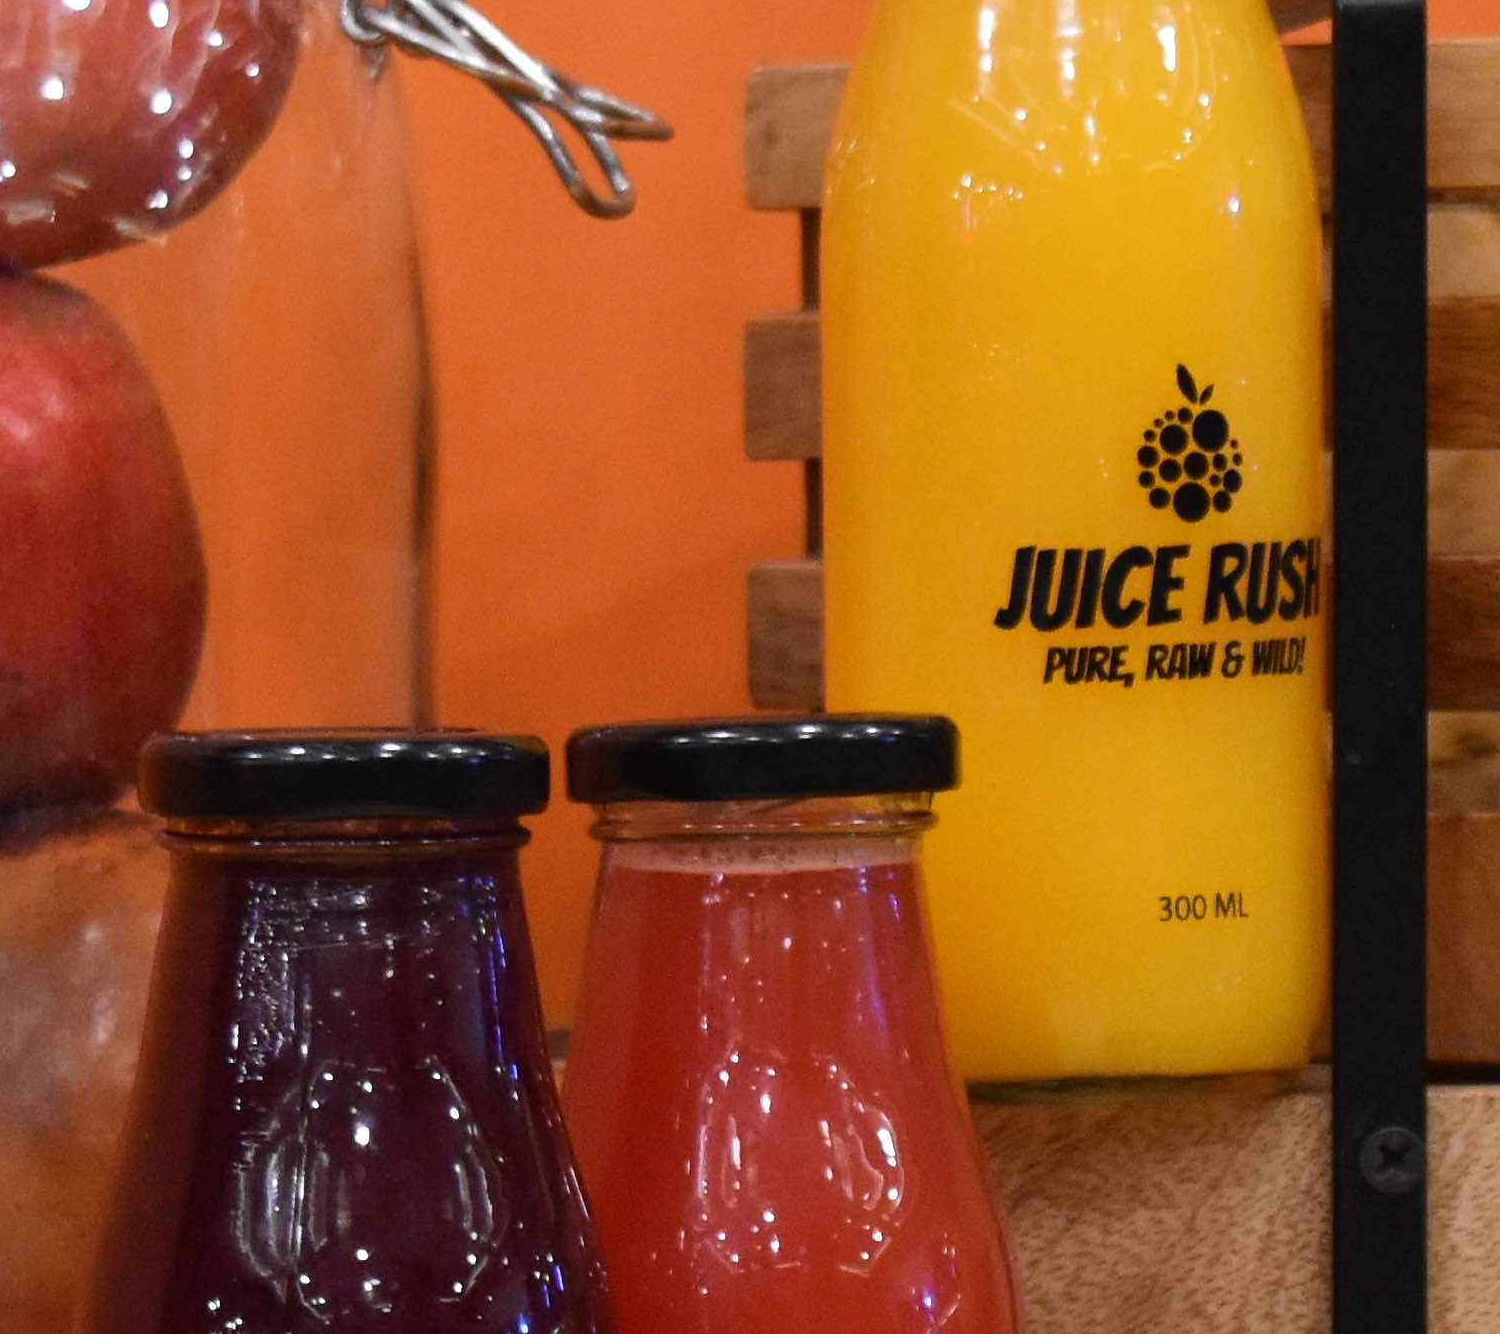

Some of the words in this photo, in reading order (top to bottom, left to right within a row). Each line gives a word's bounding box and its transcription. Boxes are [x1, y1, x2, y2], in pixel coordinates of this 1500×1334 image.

[993, 544, 1191, 632] JUICE
[1203, 538, 1321, 625] RUSH
[1044, 644, 1135, 688] PURE,
[1145, 641, 1217, 682] RAW
[1221, 640, 1245, 678] &
[1252, 635, 1307, 676] WILD!
[1158, 894, 1207, 923] 300
[1214, 891, 1249, 920] ML
